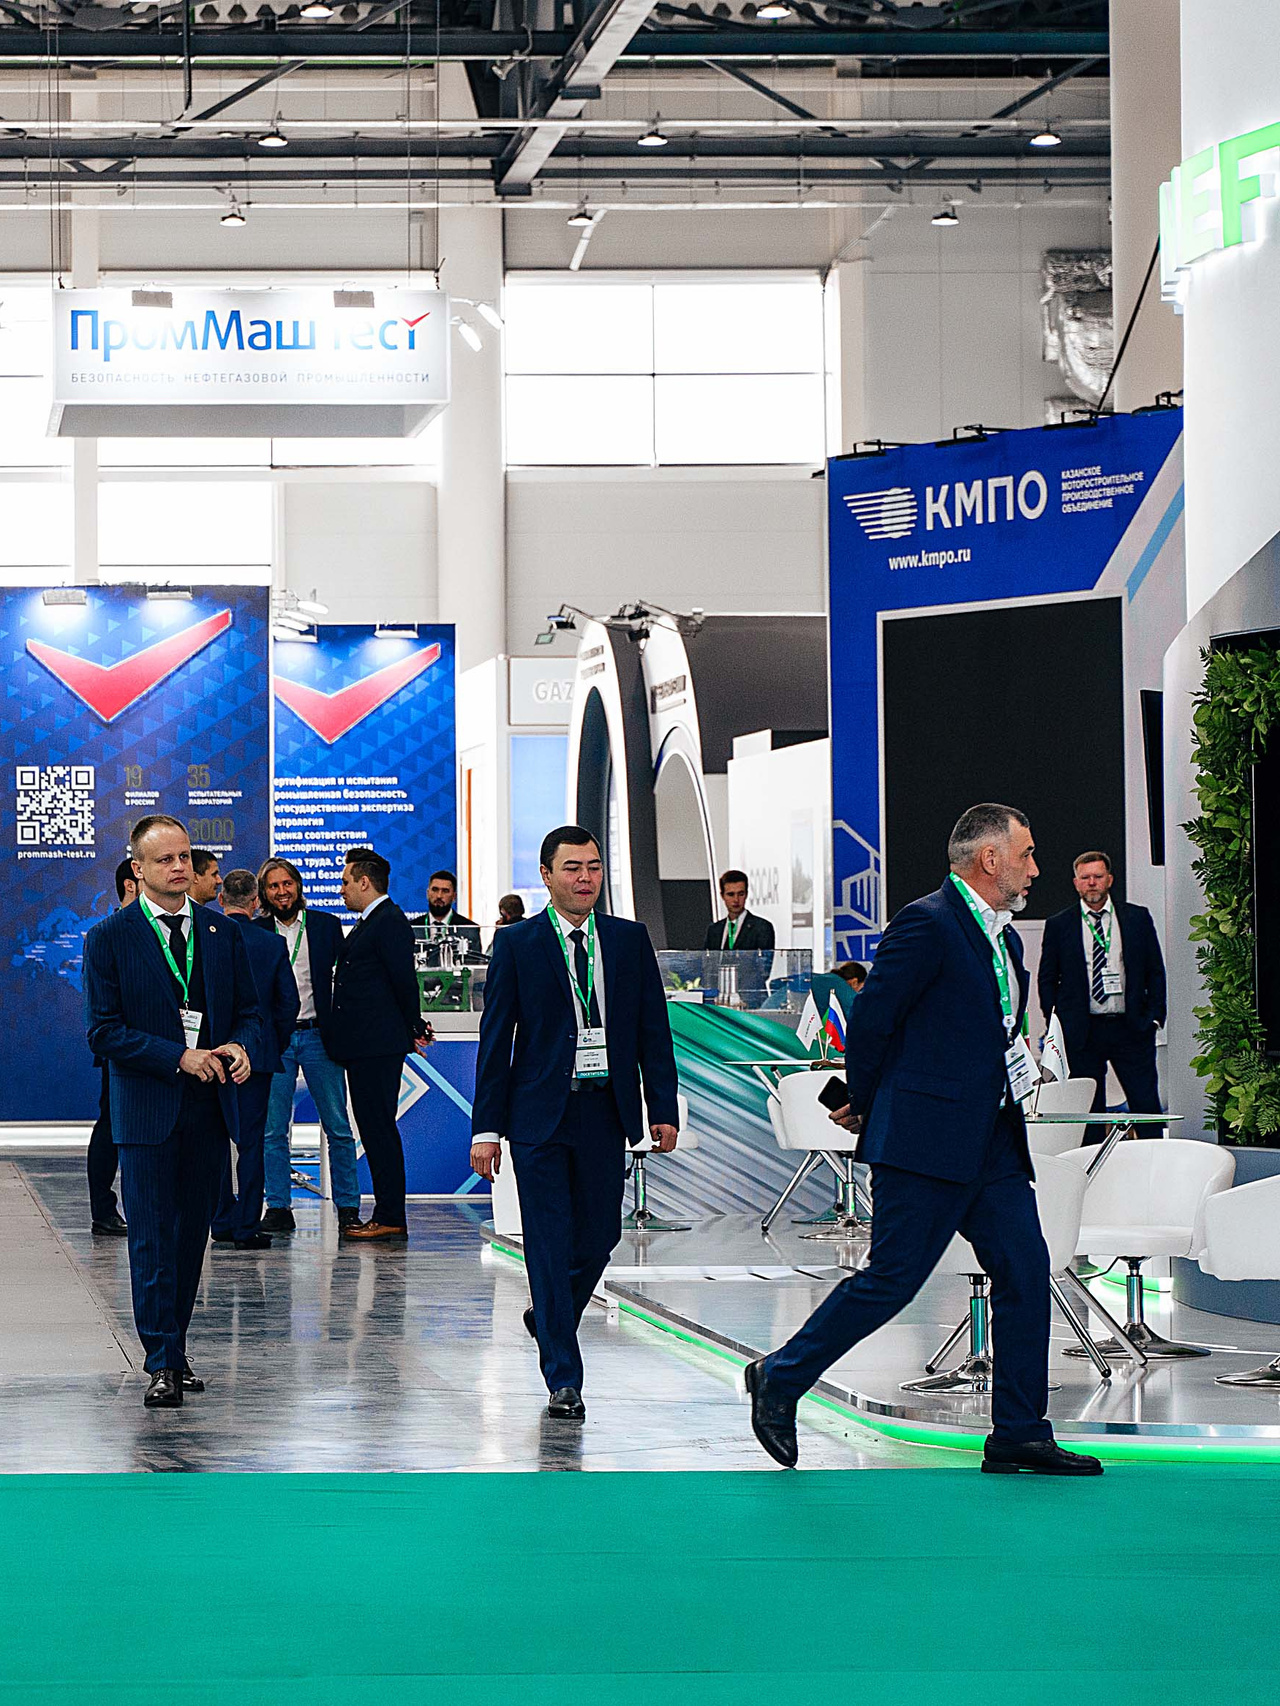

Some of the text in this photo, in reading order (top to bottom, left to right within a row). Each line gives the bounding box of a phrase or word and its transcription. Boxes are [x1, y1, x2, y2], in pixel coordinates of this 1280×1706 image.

[71, 371, 430, 383] БЕЗОПАСНОСТЬ НЕФТЕГАЗОВОЙ ПРОМЫШЛЕННОСТИ
[1061, 465, 1102, 479] КАЗАНСКОЕ
[1061, 471, 1144, 490] МОТОРОСТРОИТЕЛЬНОЕ
[1061, 484, 1135, 502] ПРОИЗВОДСТВЕННОЕ
[925, 470, 1048, 530] КМПО
[1061, 498, 1114, 513] ОБЪЕДИНЕНИЕ
[888, 548, 971, 570] www.kmpo.ru
[124, 764, 210, 788] 19 35
[273, 776, 398, 788] ертификация и испытания
[274, 788, 408, 801] ромышленная безопасность
[188, 798, 233, 806] ЛАБОРАТОРИЙ
[274, 803, 415, 815] егосударственная экспертиза
[274, 831, 368, 841] ценка соответствия
[273, 843, 335, 853] ранспортных
[17, 850, 96, 860] prommash-test.ru
